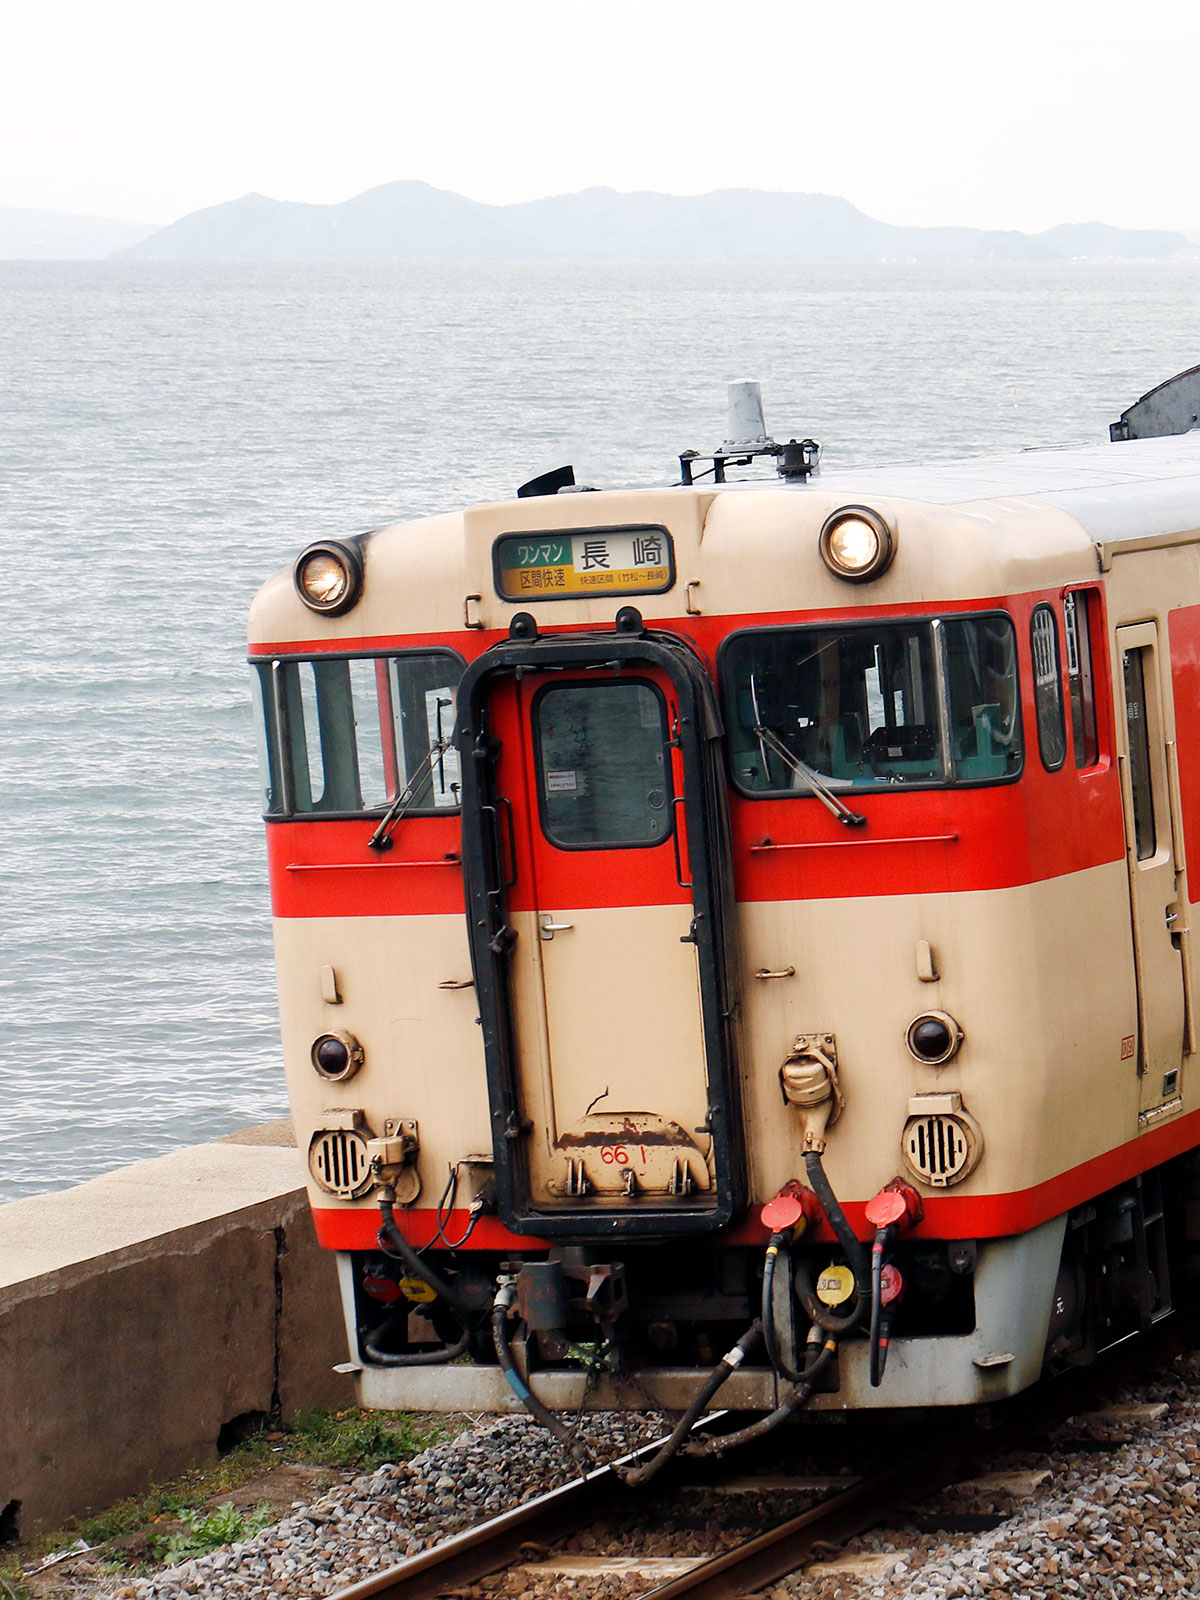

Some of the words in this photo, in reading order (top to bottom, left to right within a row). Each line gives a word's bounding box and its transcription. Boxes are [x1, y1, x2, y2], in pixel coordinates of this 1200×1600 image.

[517, 543, 563, 565] ワンマン
[519, 568, 566, 590] 区間快速
[600, 1145, 630, 1165] 66
